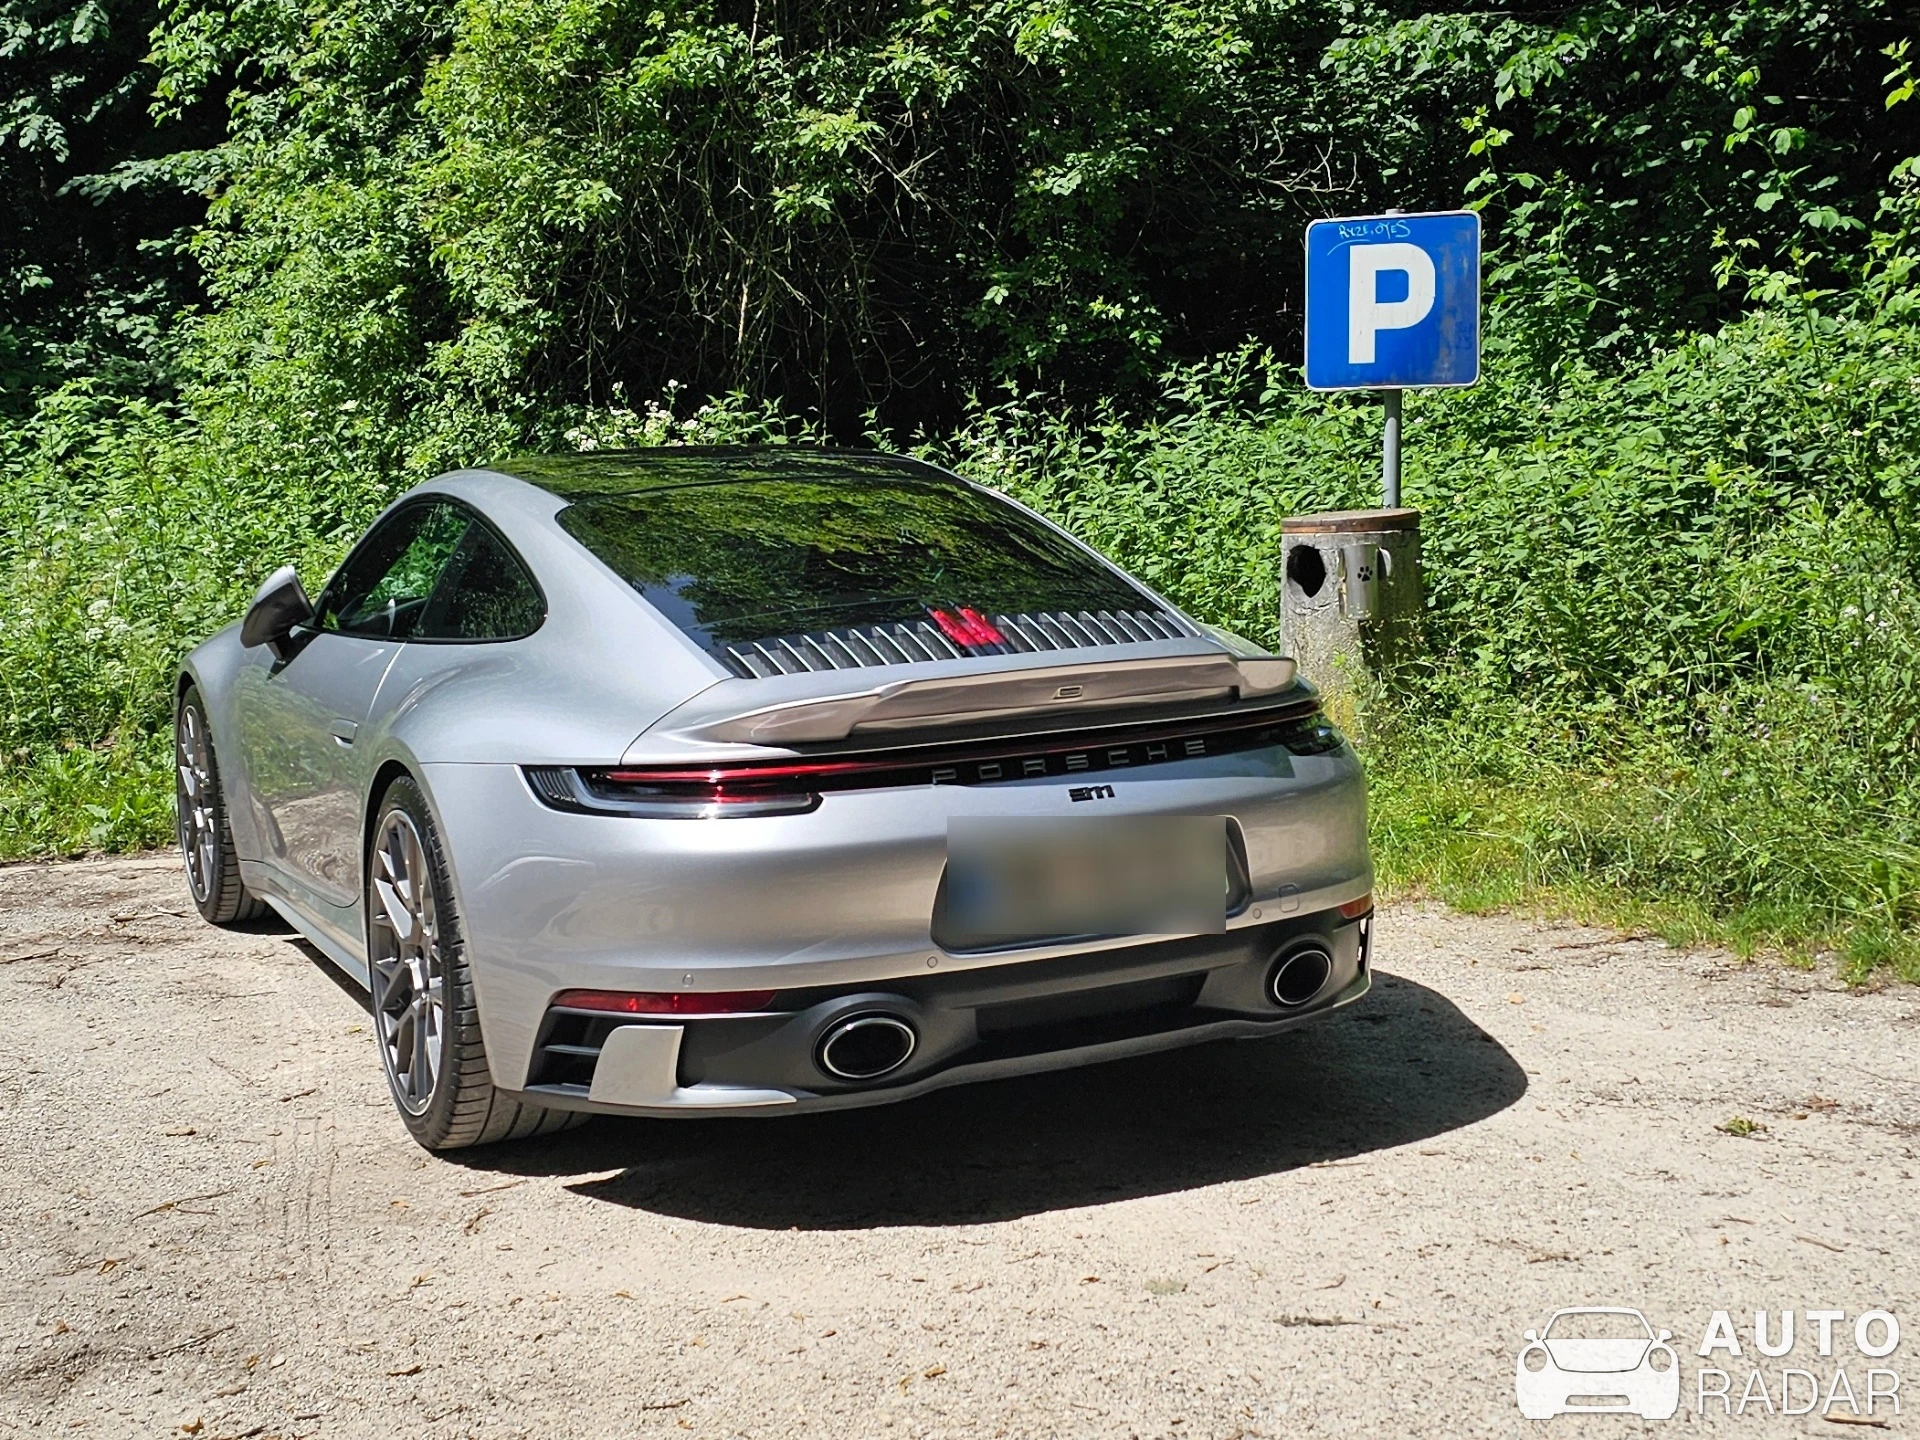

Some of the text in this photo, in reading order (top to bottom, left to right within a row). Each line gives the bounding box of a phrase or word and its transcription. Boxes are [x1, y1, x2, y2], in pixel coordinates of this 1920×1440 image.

[1349, 243, 1435, 364] P
[931, 740, 1206, 785] PORSCHE
[1068, 785, 1115, 802] 911
